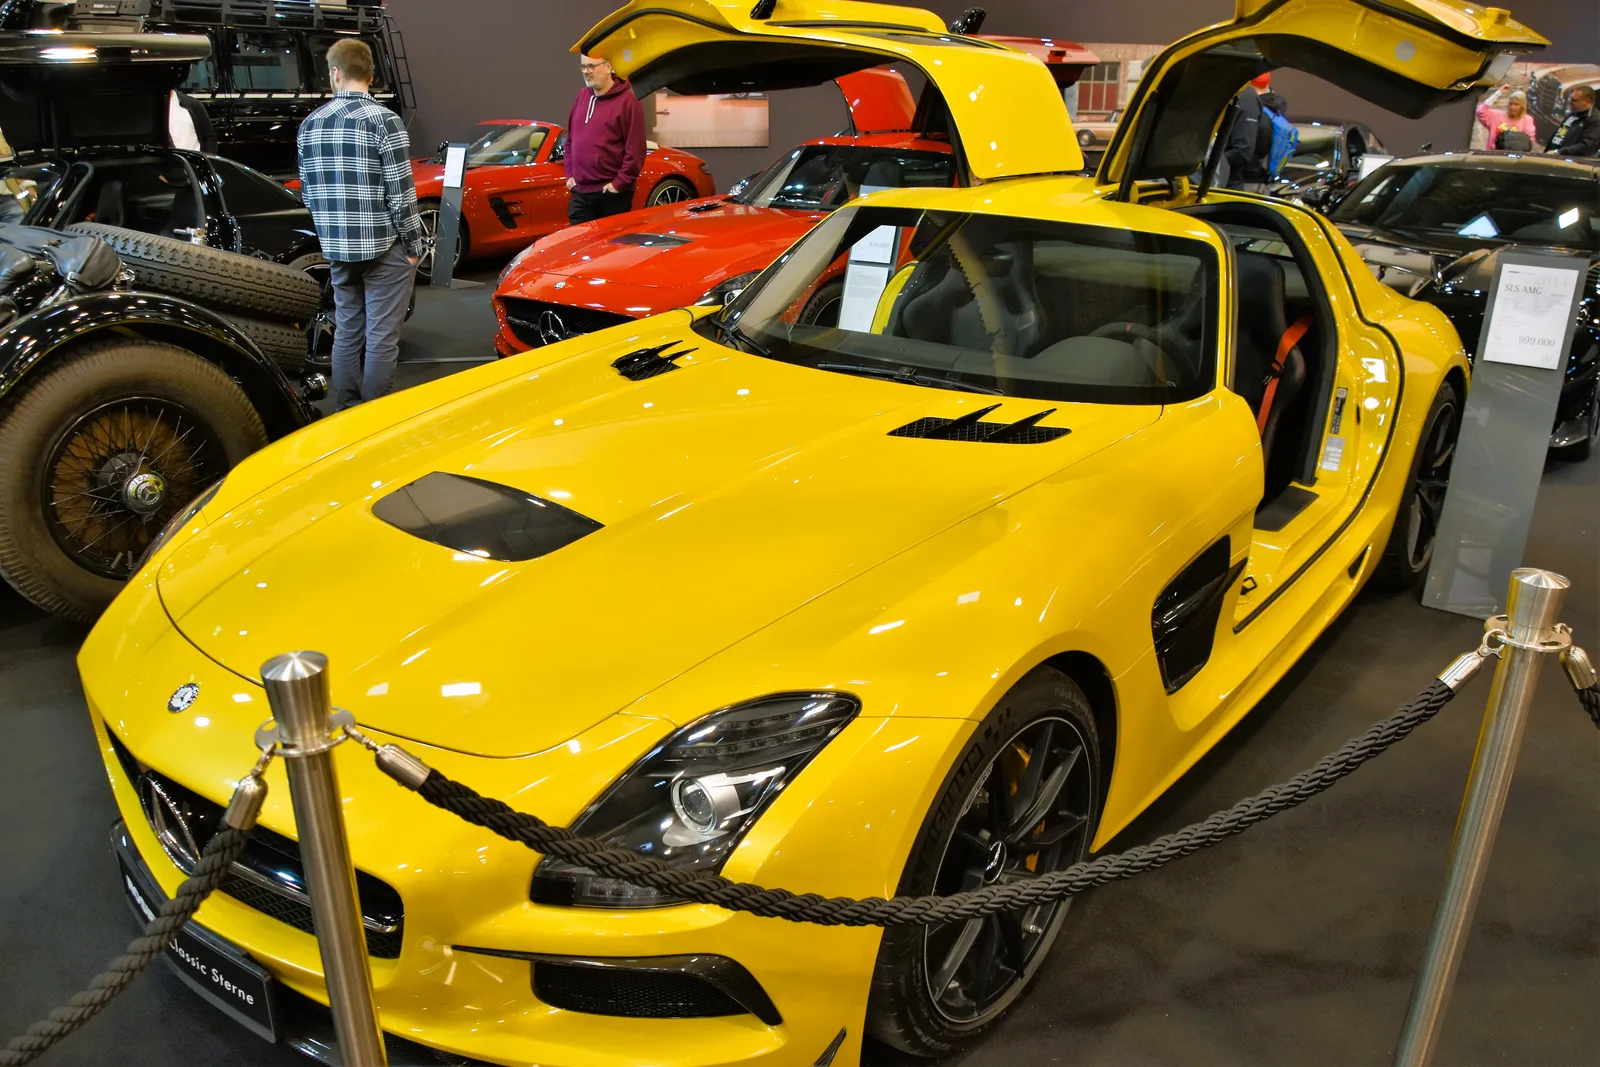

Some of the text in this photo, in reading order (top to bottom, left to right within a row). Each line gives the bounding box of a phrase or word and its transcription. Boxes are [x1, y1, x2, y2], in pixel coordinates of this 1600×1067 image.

[1504, 284, 1520, 293] SLS
[1522, 285, 1543, 295] AMG
[1518, 335, 1556, 348] 999.000
[1054, 687, 1072, 700] Pilot
[211, 968, 254, 1005] Sterne
